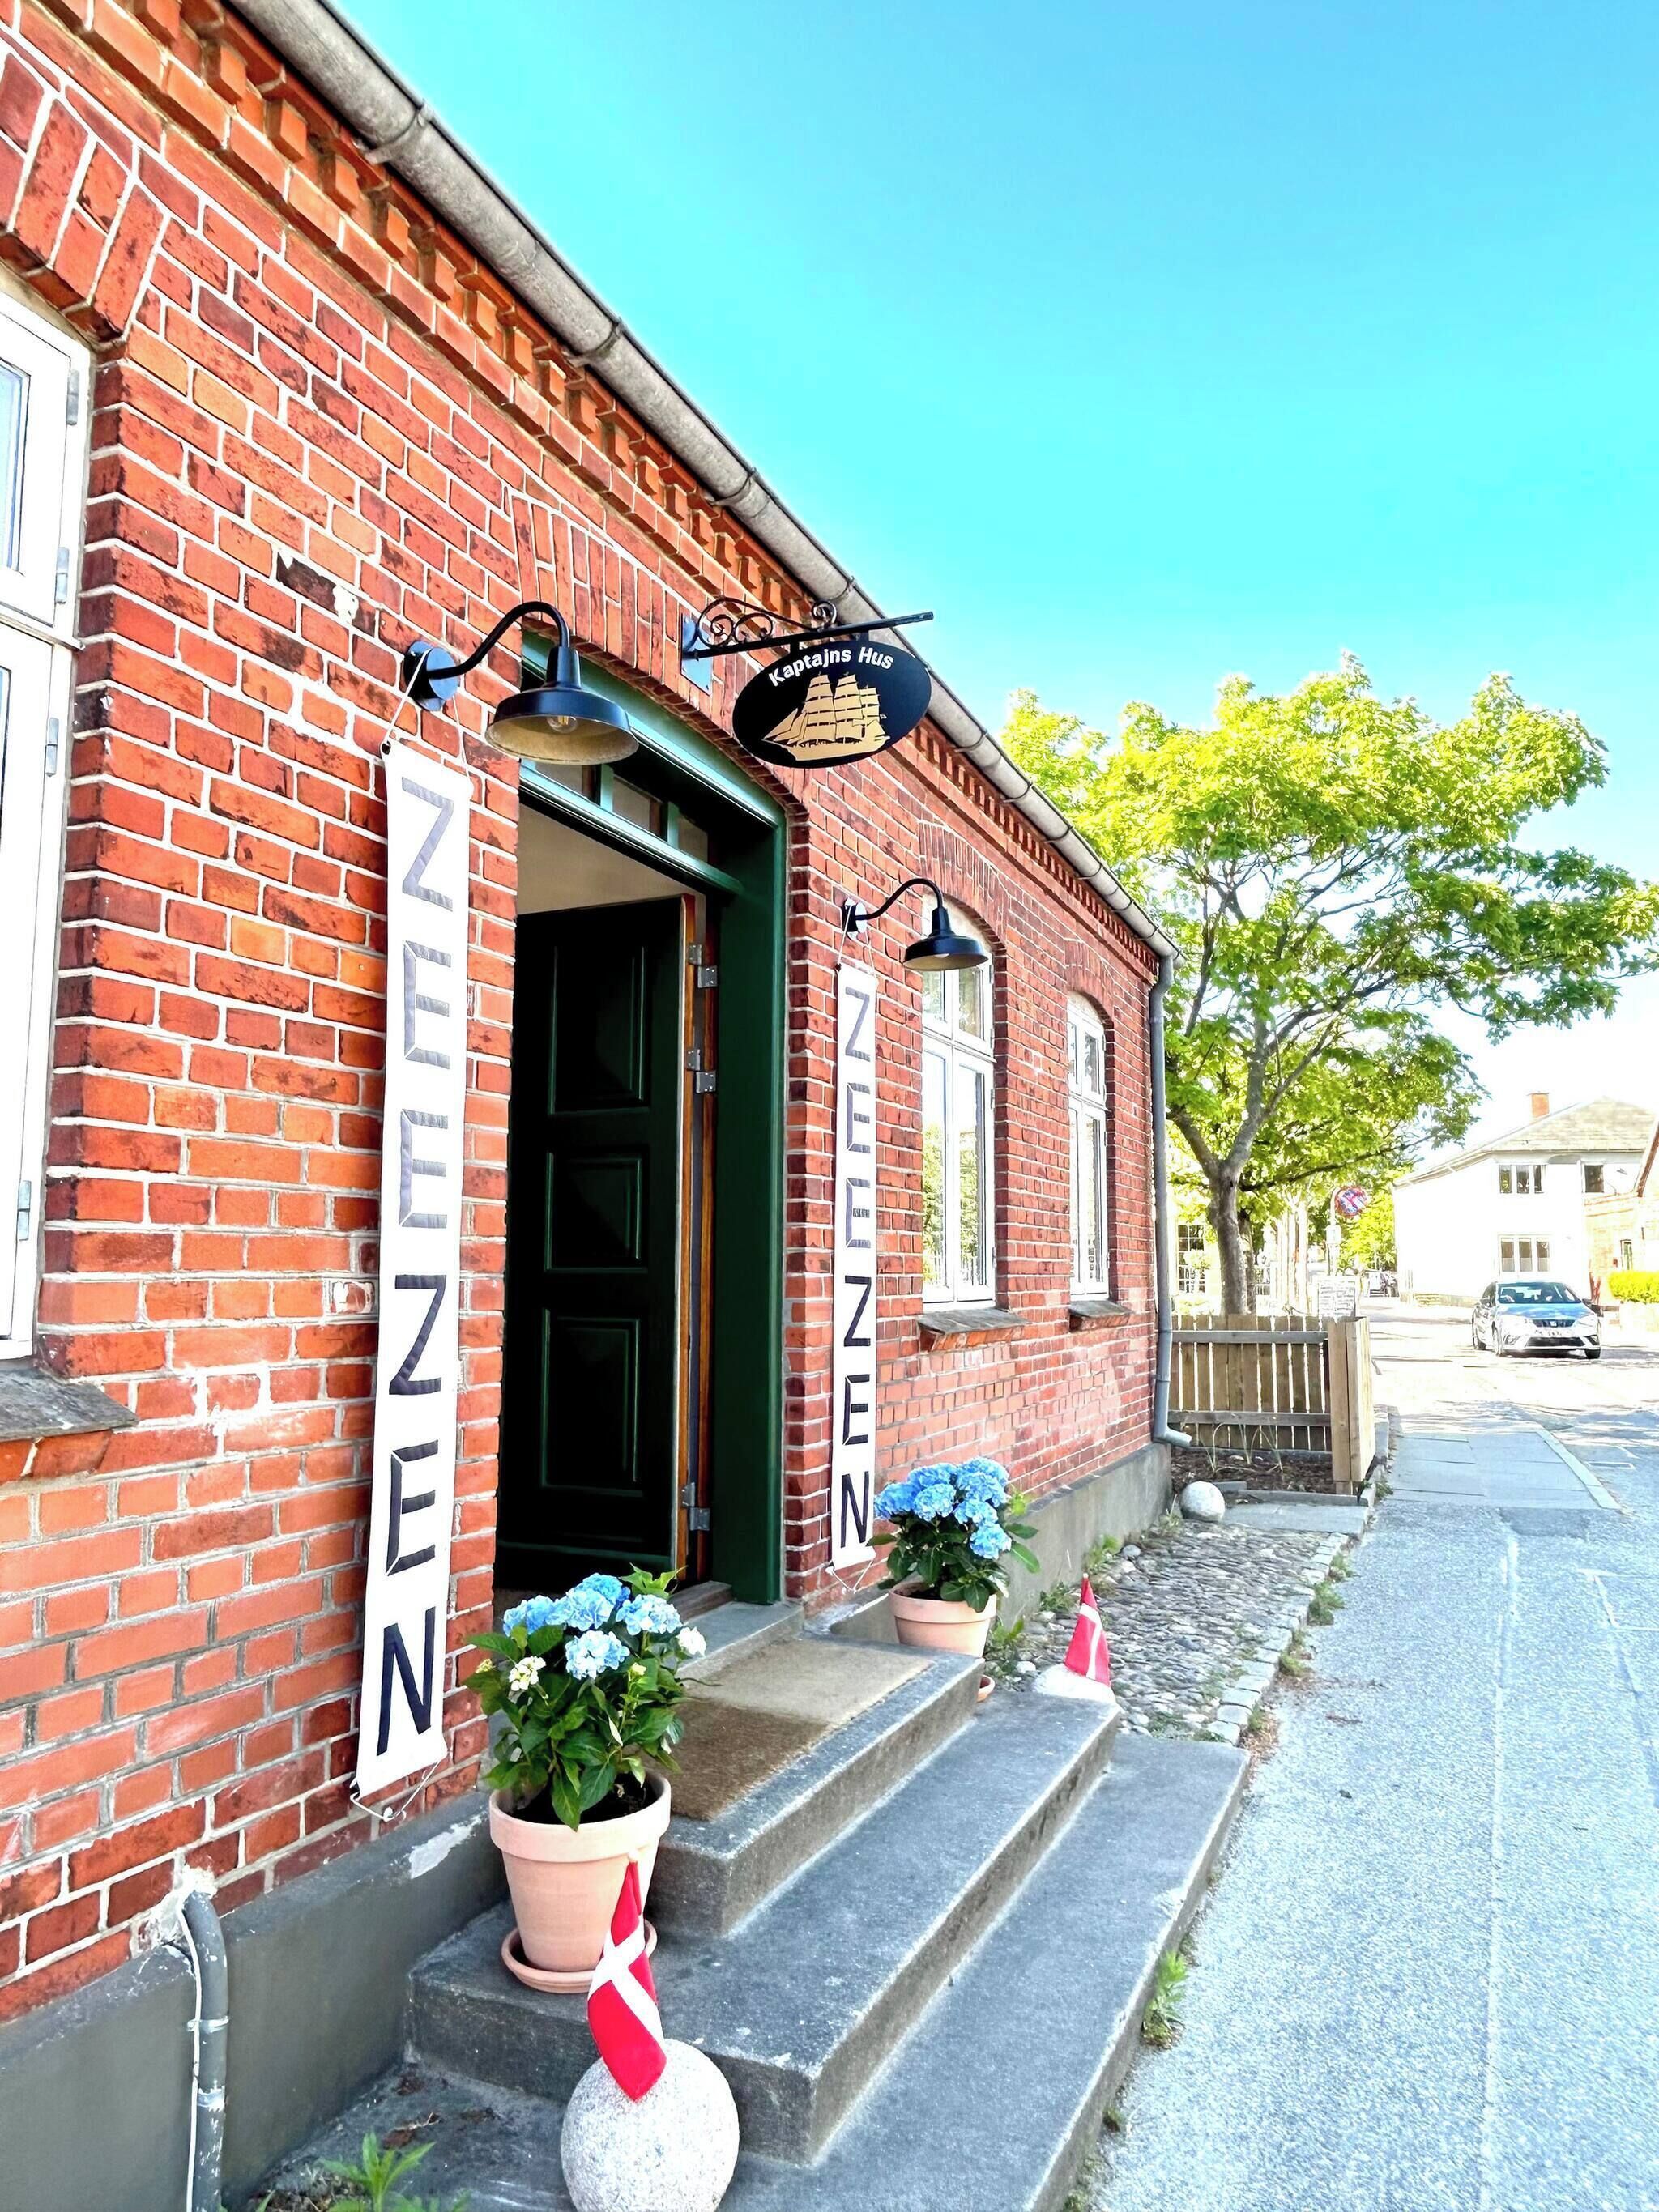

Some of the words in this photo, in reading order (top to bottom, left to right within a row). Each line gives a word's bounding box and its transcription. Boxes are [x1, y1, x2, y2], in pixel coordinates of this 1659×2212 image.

[768, 648, 852, 687] Kaptajns
[858, 646, 894, 670] Hus
[377, 776, 454, 1757] ZEEZEN
[840, 986, 872, 1549] ZEEZEN
